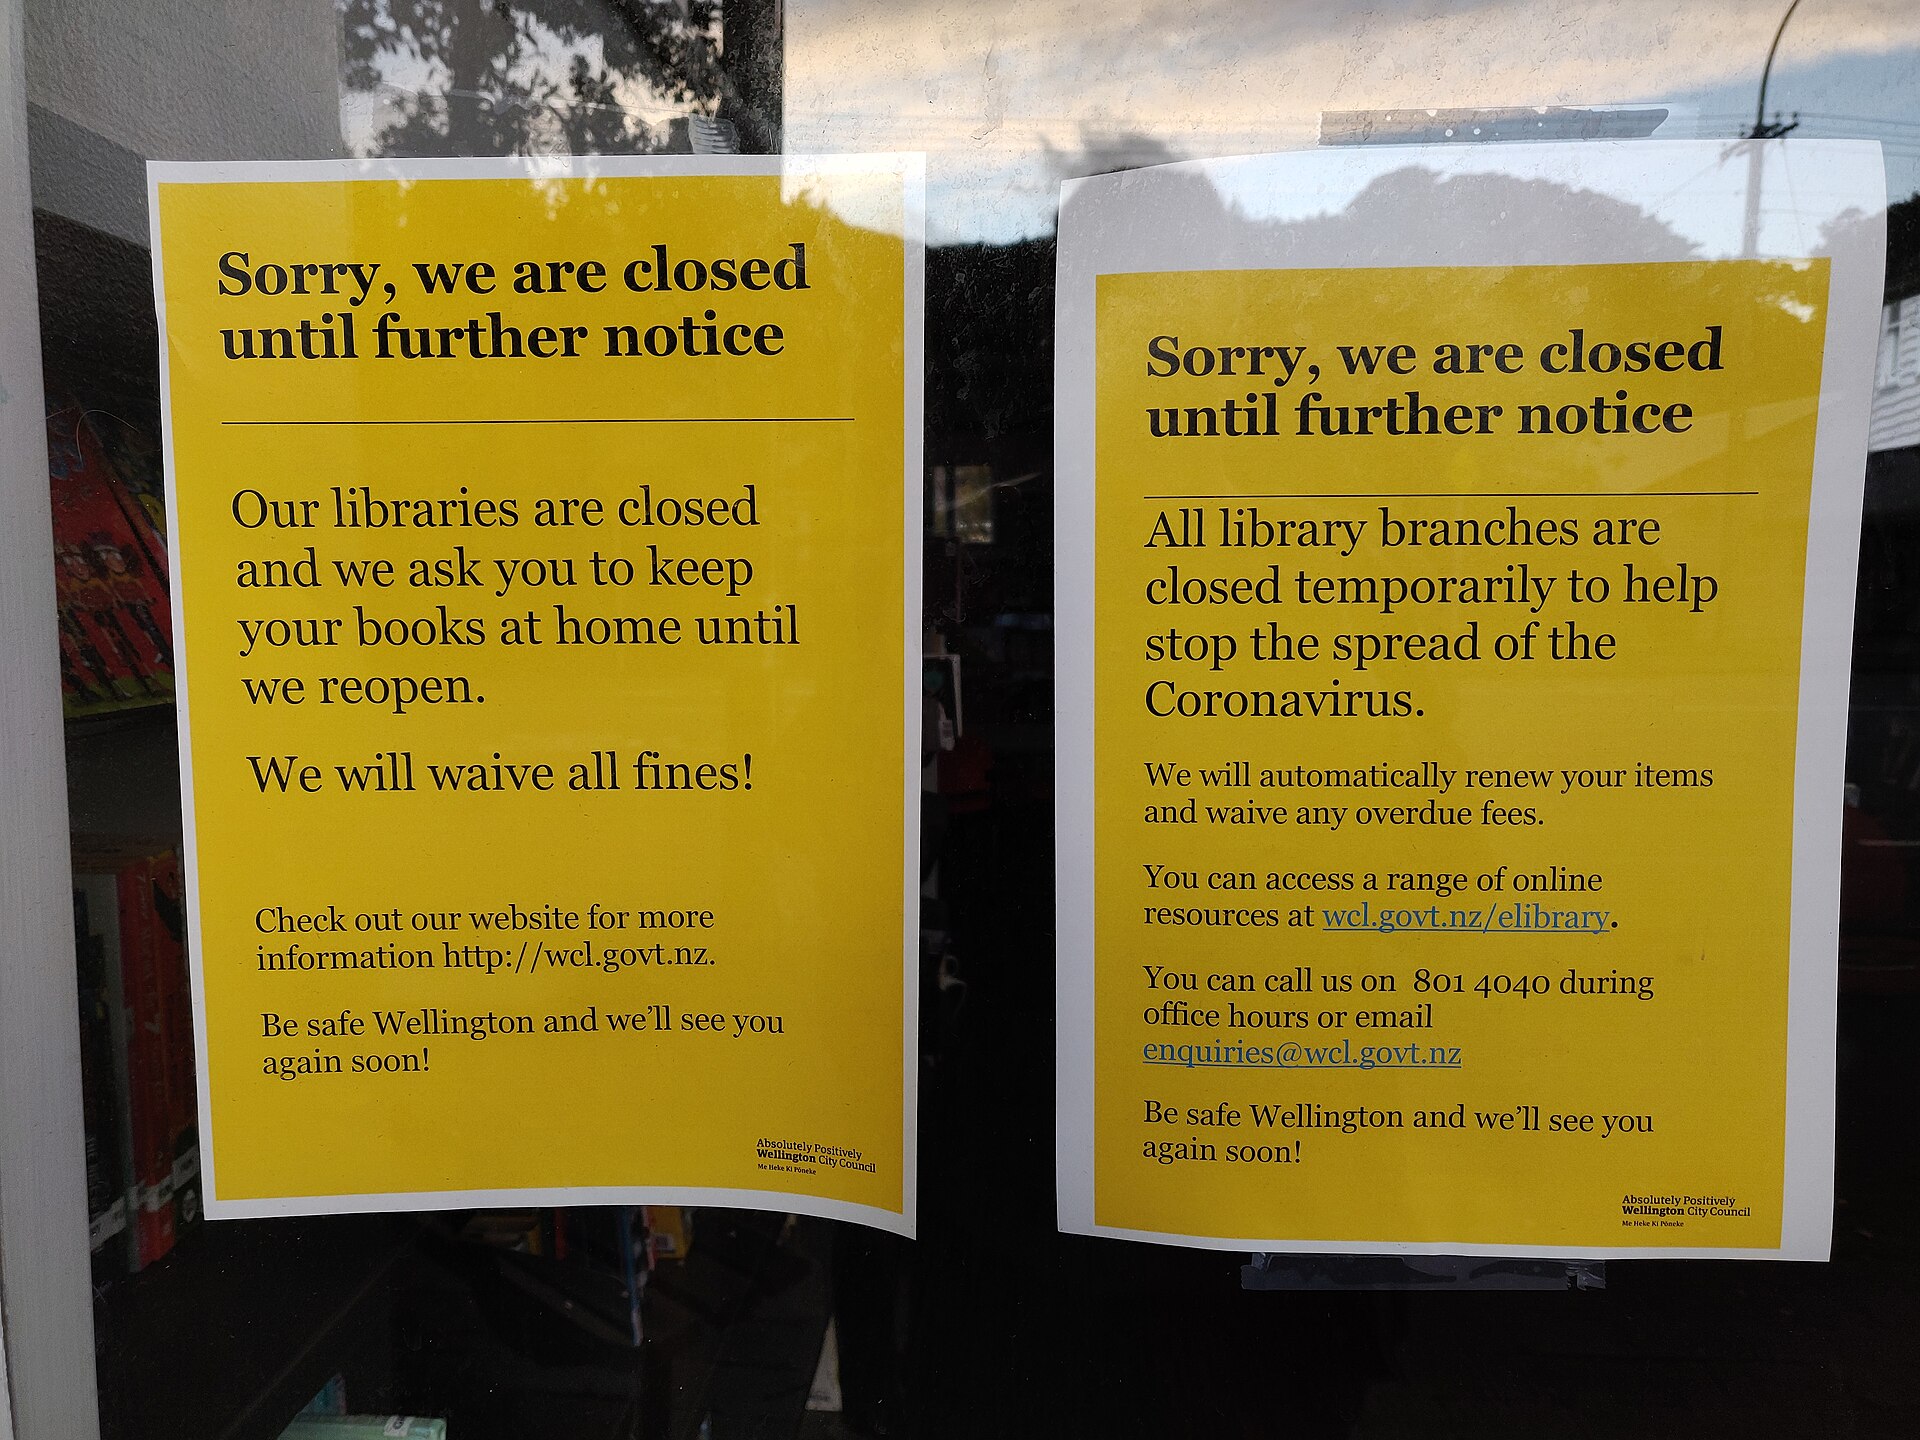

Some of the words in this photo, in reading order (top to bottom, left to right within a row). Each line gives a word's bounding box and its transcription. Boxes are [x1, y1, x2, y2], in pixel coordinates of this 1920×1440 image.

[218, 251, 397, 307] Sorry,
[411, 262, 497, 295] we
[512, 260, 608, 294] are
[623, 242, 812, 293] closed
[219, 312, 360, 360] until
[371, 311, 589, 360] further
[602, 308, 785, 357] notice
[1147, 335, 1321, 388] Sorry,
[1336, 344, 1417, 375] we
[1432, 343, 1524, 375] are
[1539, 325, 1725, 374] closed
[1145, 392, 1281, 438] until
[1294, 390, 1504, 437] further
[1517, 389, 1693, 435] notice
[231, 489, 320, 529] Our
[329, 486, 519, 529] libraries
[534, 498, 605, 527] are
[618, 484, 761, 527] closed
[1143, 507, 1207, 548] All
[1218, 507, 1368, 557] library
[1377, 505, 1579, 548] branches
[1592, 518, 1661, 546] are
[236, 546, 323, 588] and
[331, 559, 395, 588] we
[408, 545, 485, 588] ask
[492, 558, 578, 598] you
[588, 551, 635, 587] to
[645, 544, 753, 597] keep
[1146, 564, 1283, 605] closed
[1294, 563, 1558, 614] temporarily
[1566, 569, 1610, 604] to
[1622, 562, 1718, 613] help
[236, 618, 343, 658] your
[352, 604, 486, 647] books
[500, 610, 543, 646] at
[552, 604, 682, 645] home
[694, 604, 801, 645] until
[1145, 628, 1237, 672] stop
[1249, 621, 1320, 661] the
[1332, 620, 1482, 671] spread
[1494, 620, 1541, 661] of
[1547, 620, 1617, 661] the
[240, 677, 306, 705] we
[318, 676, 485, 715] reopen.
[1145, 678, 1424, 718] Coronavirus.
[245, 755, 323, 793] We
[333, 751, 417, 792] will
[426, 752, 555, 792] waive
[568, 750, 621, 791] all
[632, 750, 752, 791] fines!
[1143, 762, 1192, 787] We
[1198, 761, 1252, 787] will
[1259, 761, 1458, 795] automatically
[1464, 770, 1555, 788] renew
[1560, 769, 1628, 795] your
[1634, 761, 1714, 788] items
[1144, 797, 1198, 824] and
[1204, 799, 1288, 825] waive
[1295, 806, 1349, 831] any
[1355, 798, 1473, 826] overdue
[1480, 799, 1544, 826] fees.
[1142, 864, 1200, 890] You
[1207, 872, 1258, 890] can
[1265, 872, 1355, 891] access
[1362, 872, 1379, 891] a
[1386, 873, 1468, 898] range
[1476, 865, 1508, 892] of
[1512, 865, 1603, 892] online
[255, 905, 348, 934] Check
[354, 908, 404, 932] out
[411, 912, 462, 931] our
[468, 903, 580, 931] website
[586, 903, 631, 930] for
[637, 910, 715, 929] more
[1143, 907, 1279, 927] resources
[1287, 905, 1315, 928] at
[1321, 901, 1619, 935] wcl.govt.nz/elibrary.
[256, 942, 436, 971] information
[441, 940, 716, 975] http://wcl.govt.nz.
[1141, 965, 1199, 991] You
[1206, 973, 1257, 992] can
[1264, 966, 1314, 993] call
[1320, 974, 1353, 993] us
[1360, 974, 1397, 993] on
[1413, 968, 1466, 993] 801
[1473, 974, 1551, 1000] 4040
[1559, 968, 1655, 1001] during
[260, 1013, 299, 1038] Be
[307, 1009, 366, 1037] safe
[371, 1008, 536, 1041] Wellington
[543, 1006, 600, 1034] and
[680, 1013, 726, 1032] see
[731, 1014, 785, 1039] you
[1143, 1000, 1220, 1028] office
[1227, 1002, 1309, 1029] hours
[1317, 1010, 1348, 1029] or
[1355, 1003, 1434, 1029] email
[262, 1048, 344, 1080] again
[351, 1047, 430, 1073] soon!
[1142, 1038, 1462, 1071] enquiries@wcl.govt.nz
[1143, 1099, 1179, 1125] Be
[1186, 1101, 1242, 1128] safe
[1248, 1103, 1405, 1134] Wellington
[1412, 1103, 1467, 1129] and
[1548, 1114, 1594, 1133] see
[1601, 1115, 1654, 1139] you
[757, 1138, 812, 1153] Absolutely
[815, 1144, 862, 1161] Positively
[757, 1149, 816, 1163] Wellington
[819, 1155, 837, 1168] City
[840, 1159, 876, 1173] Council
[1142, 1136, 1218, 1165] again
[1225, 1139, 1301, 1164] soon!
